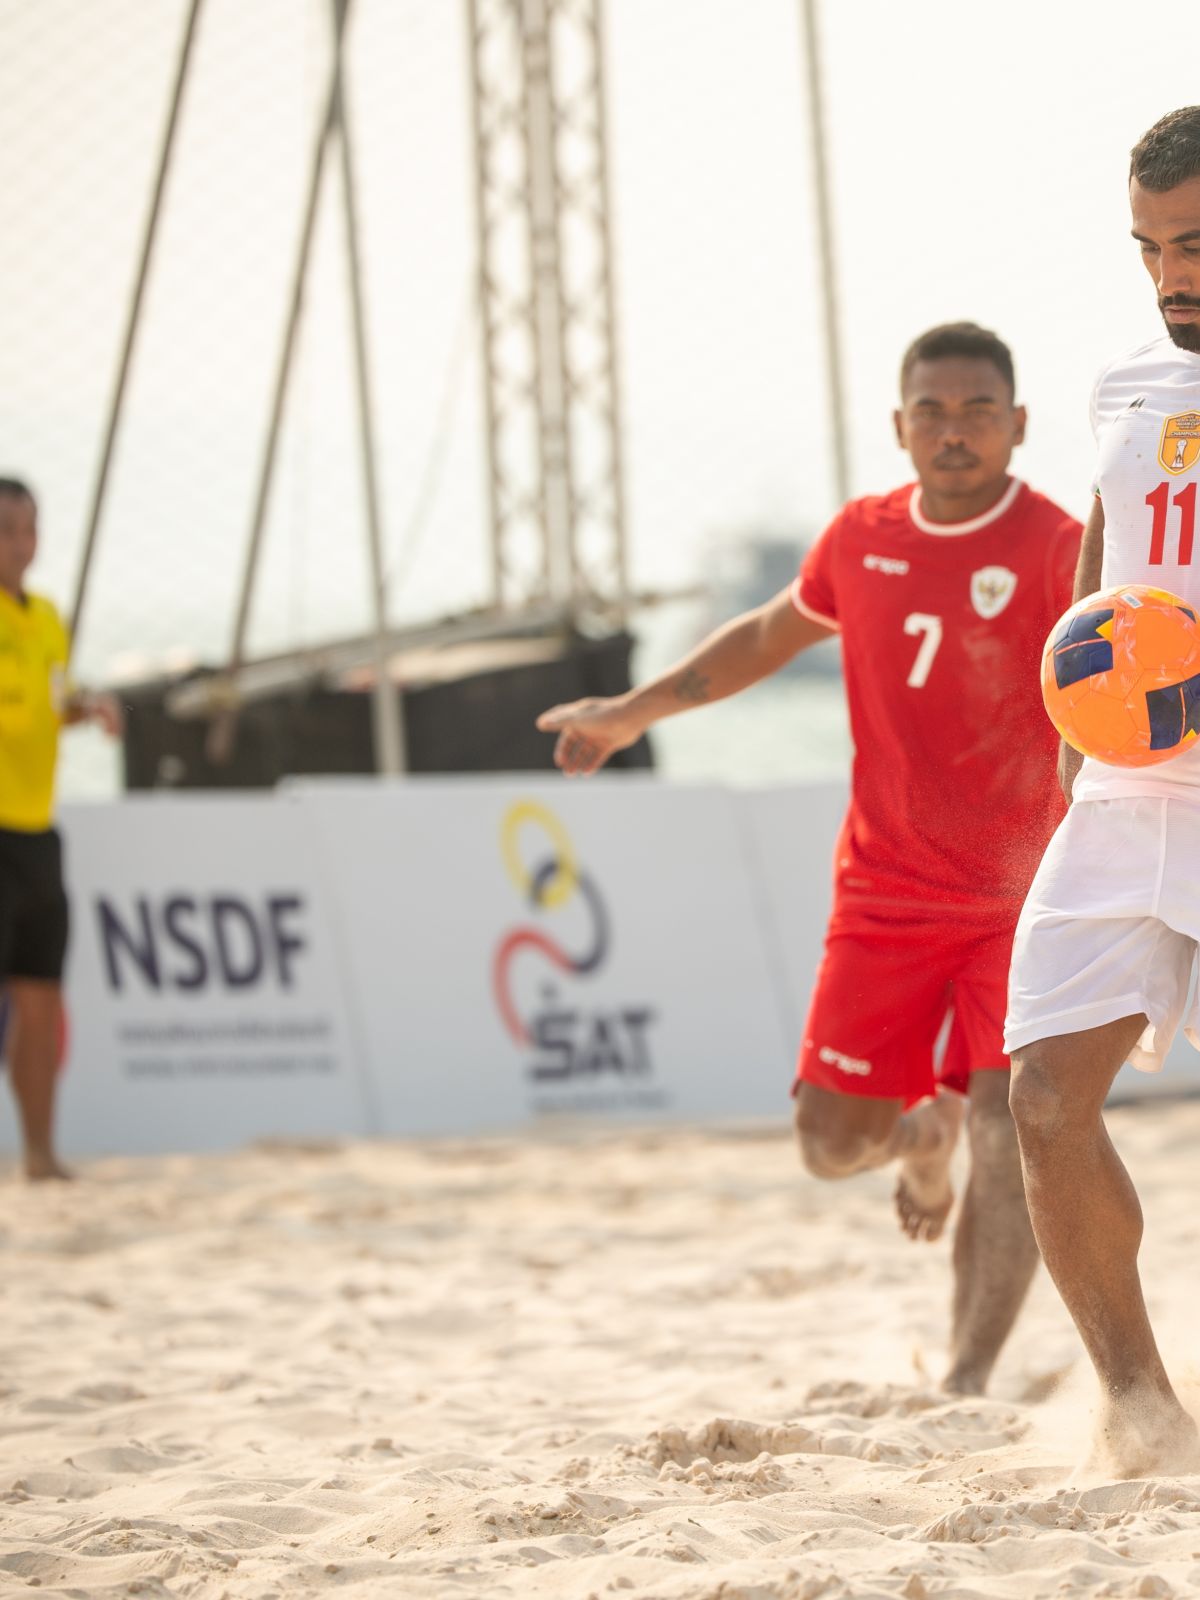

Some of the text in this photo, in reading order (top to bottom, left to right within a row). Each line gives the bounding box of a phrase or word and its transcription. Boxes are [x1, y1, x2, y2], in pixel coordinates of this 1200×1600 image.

[1145, 481, 1197, 566] 11
[903, 611, 943, 688] 7
[94, 892, 308, 993] NSDF
[527, 1006, 659, 1084] SAT
